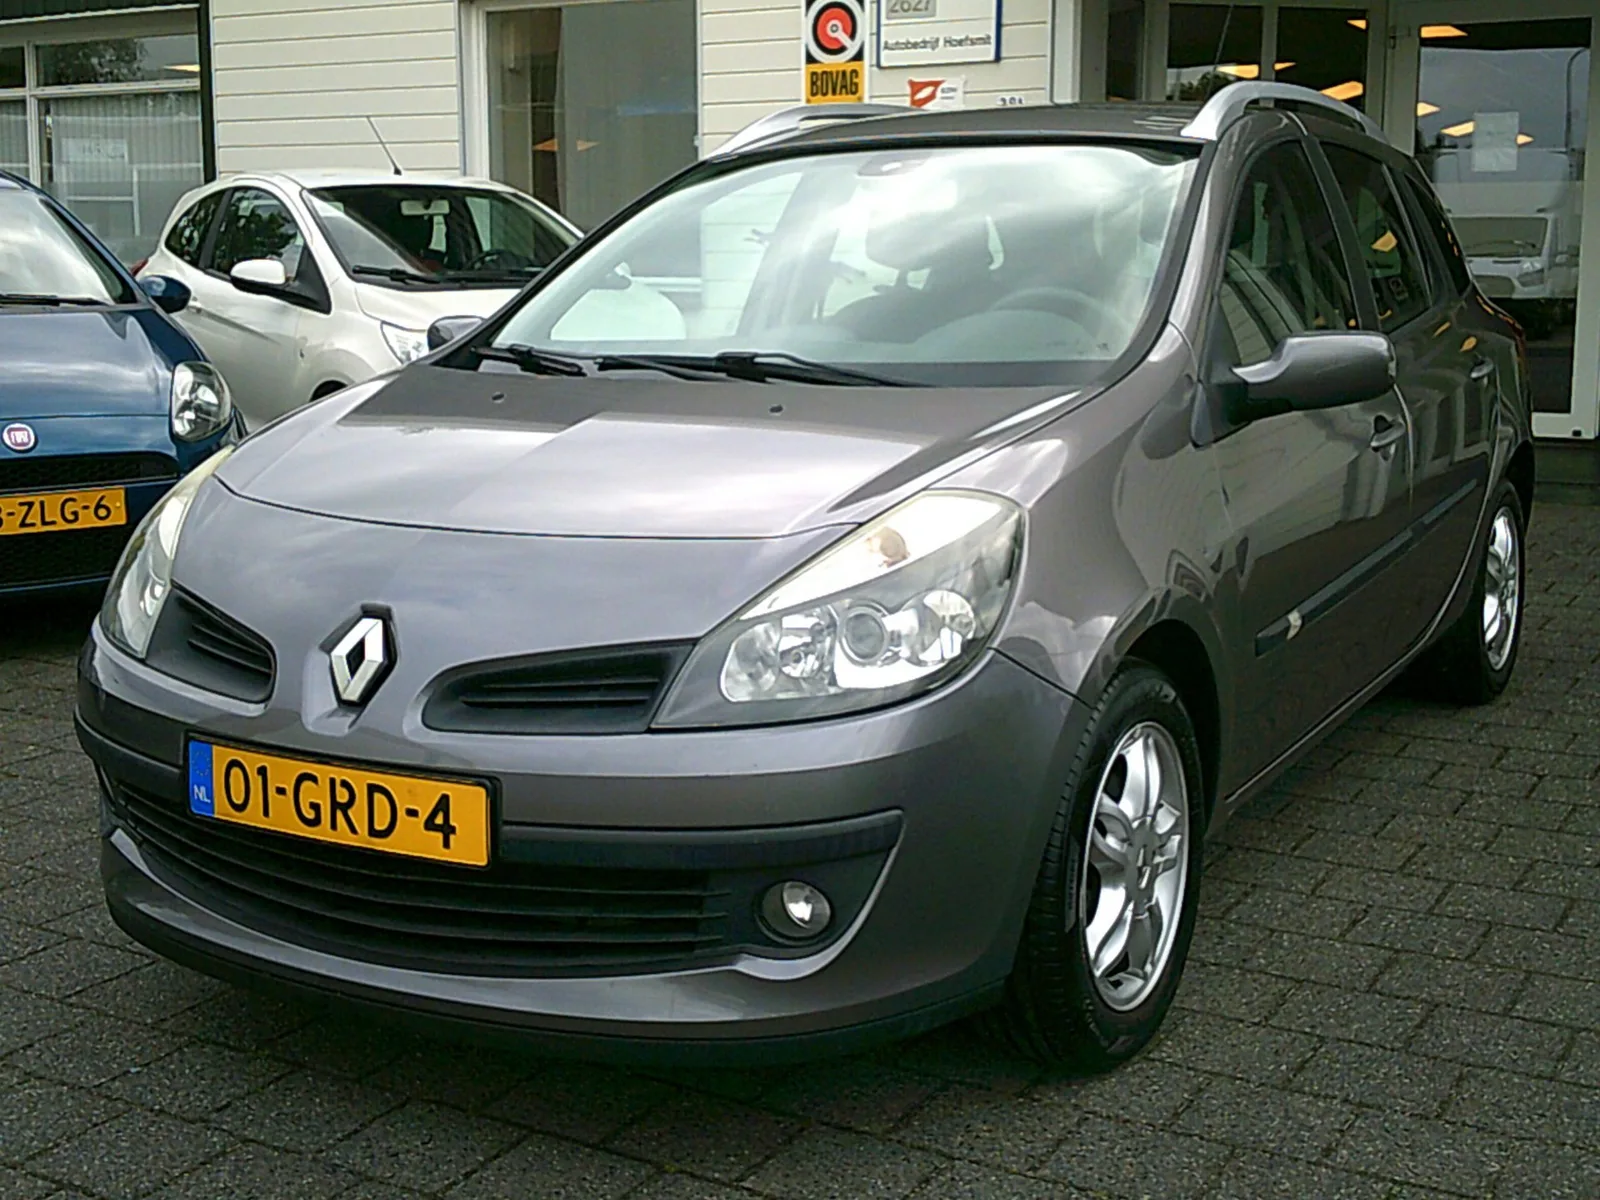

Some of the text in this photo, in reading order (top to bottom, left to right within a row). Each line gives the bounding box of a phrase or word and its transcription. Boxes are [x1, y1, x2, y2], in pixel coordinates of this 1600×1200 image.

[883, 37, 940, 51] Autobedrijf
[810, 69, 859, 97] BOVAG
[0, 495, 112, 529] -ZLG-6
[194, 784, 211, 804] NL
[224, 758, 457, 850] 01-GRD-4
